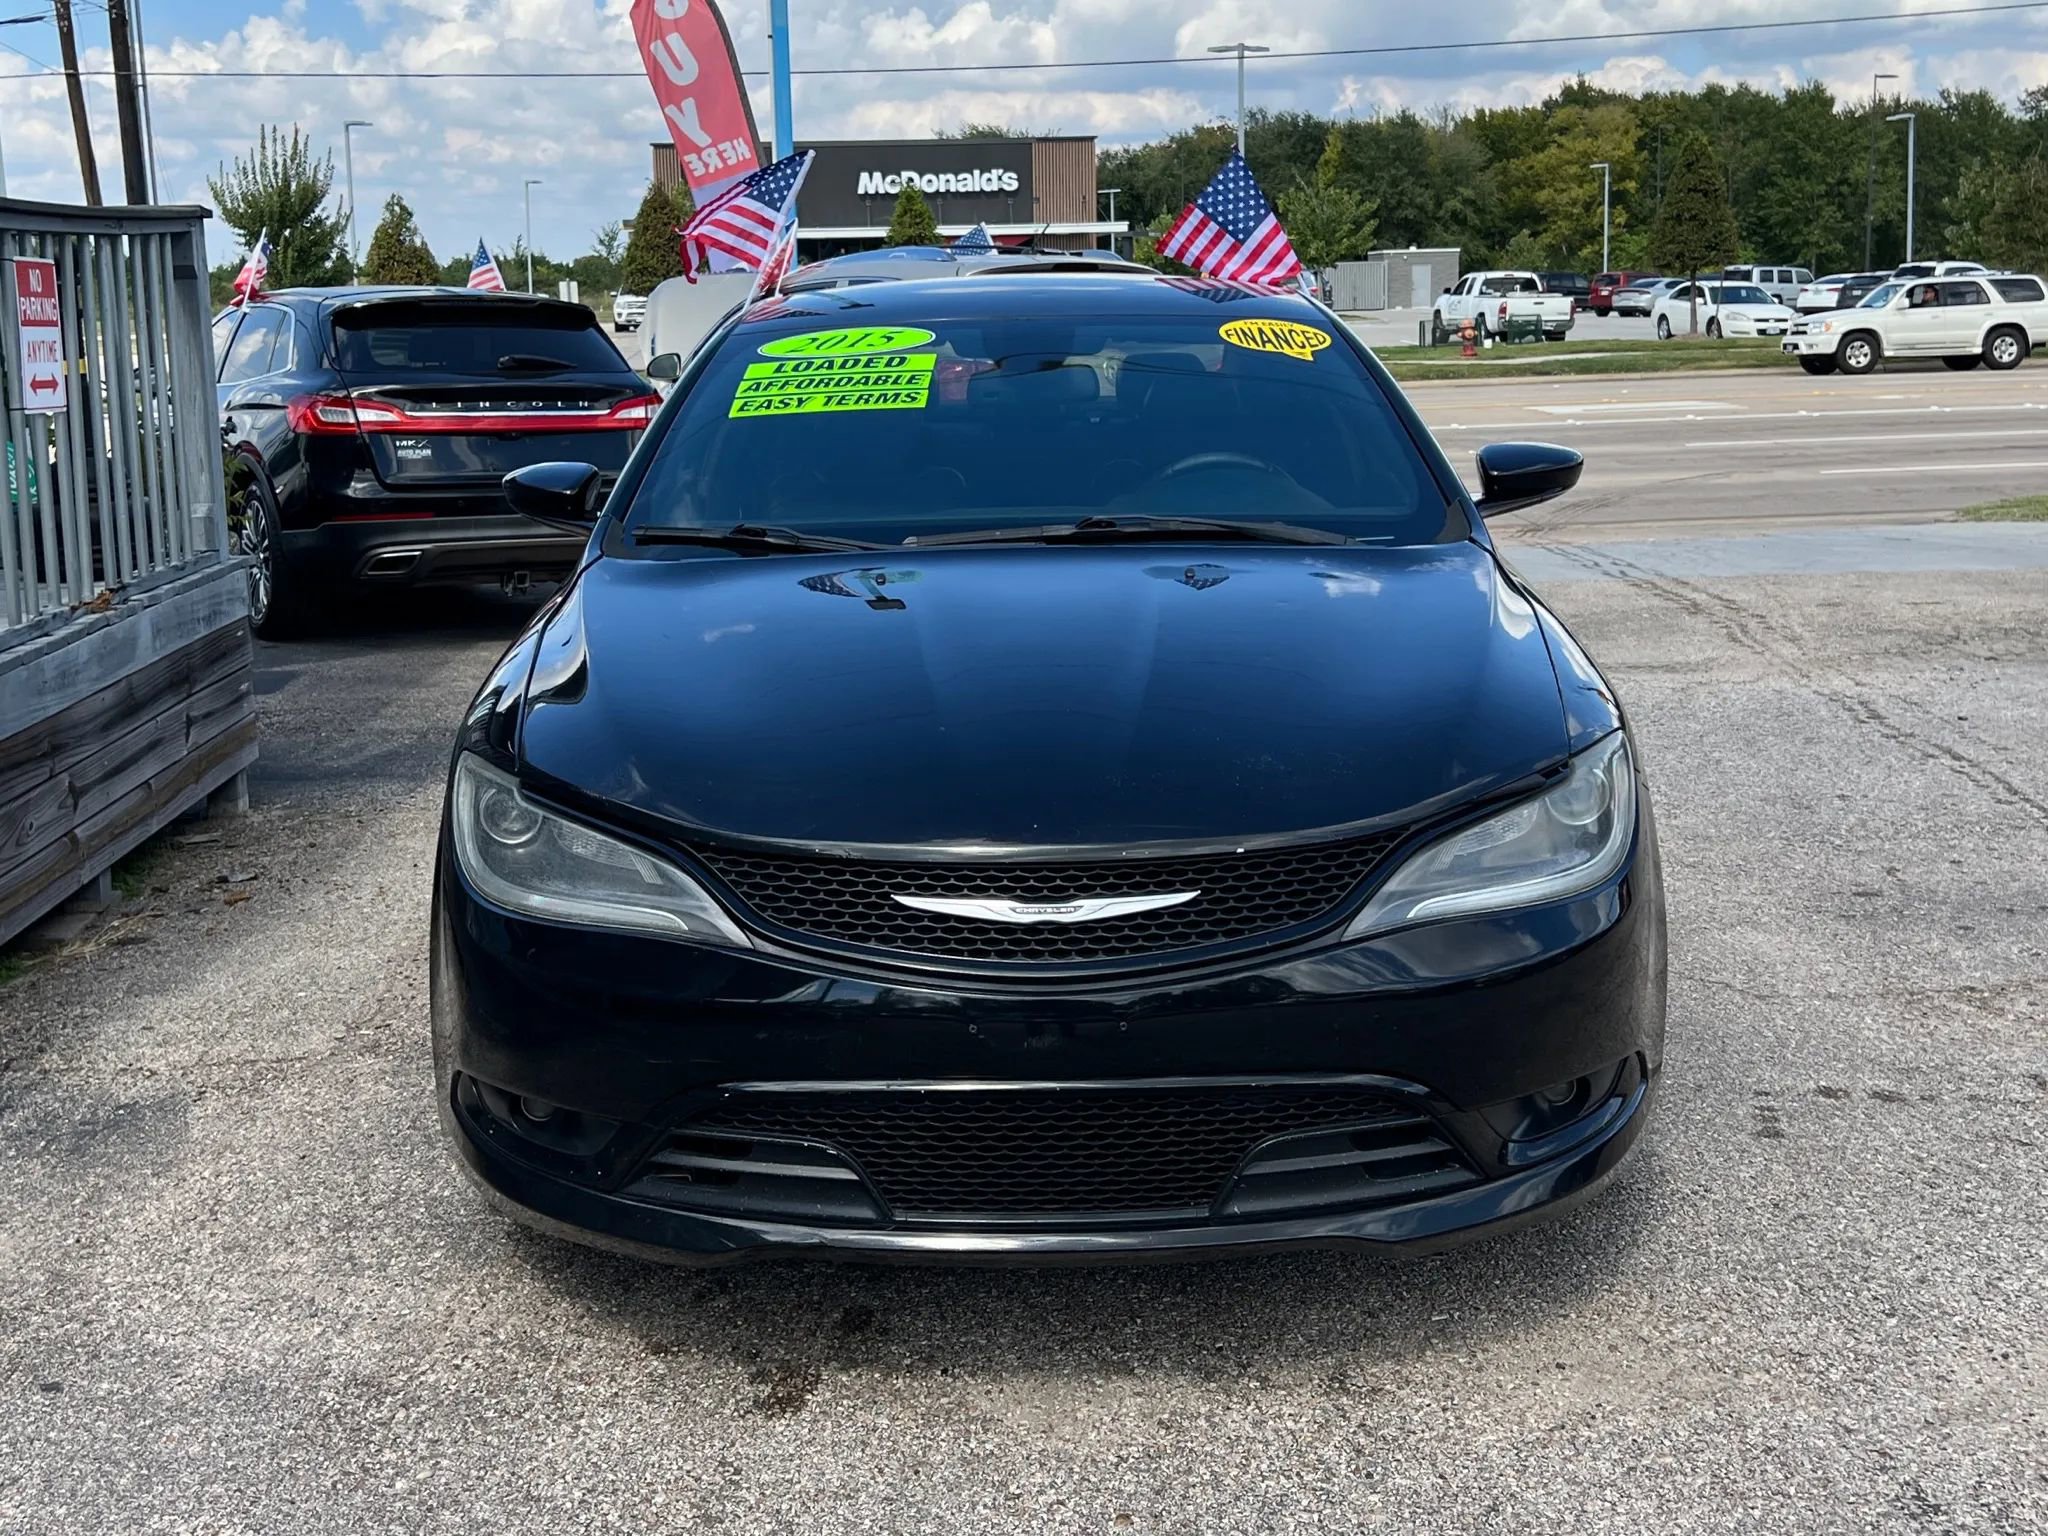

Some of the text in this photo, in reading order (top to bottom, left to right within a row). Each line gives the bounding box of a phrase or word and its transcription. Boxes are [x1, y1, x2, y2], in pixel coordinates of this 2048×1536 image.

[857, 169, 1019, 194] McDonald's
[29, 268, 42, 292] NO
[20, 296, 57, 321] PARKING
[784, 331, 904, 354] 2015
[1225, 327, 1327, 350] FINANCED
[27, 340, 58, 363] ANYTIME
[773, 356, 908, 374] LOADED
[742, 374, 924, 393] AFFORDABLE
[737, 391, 922, 412] EASY TERMS
